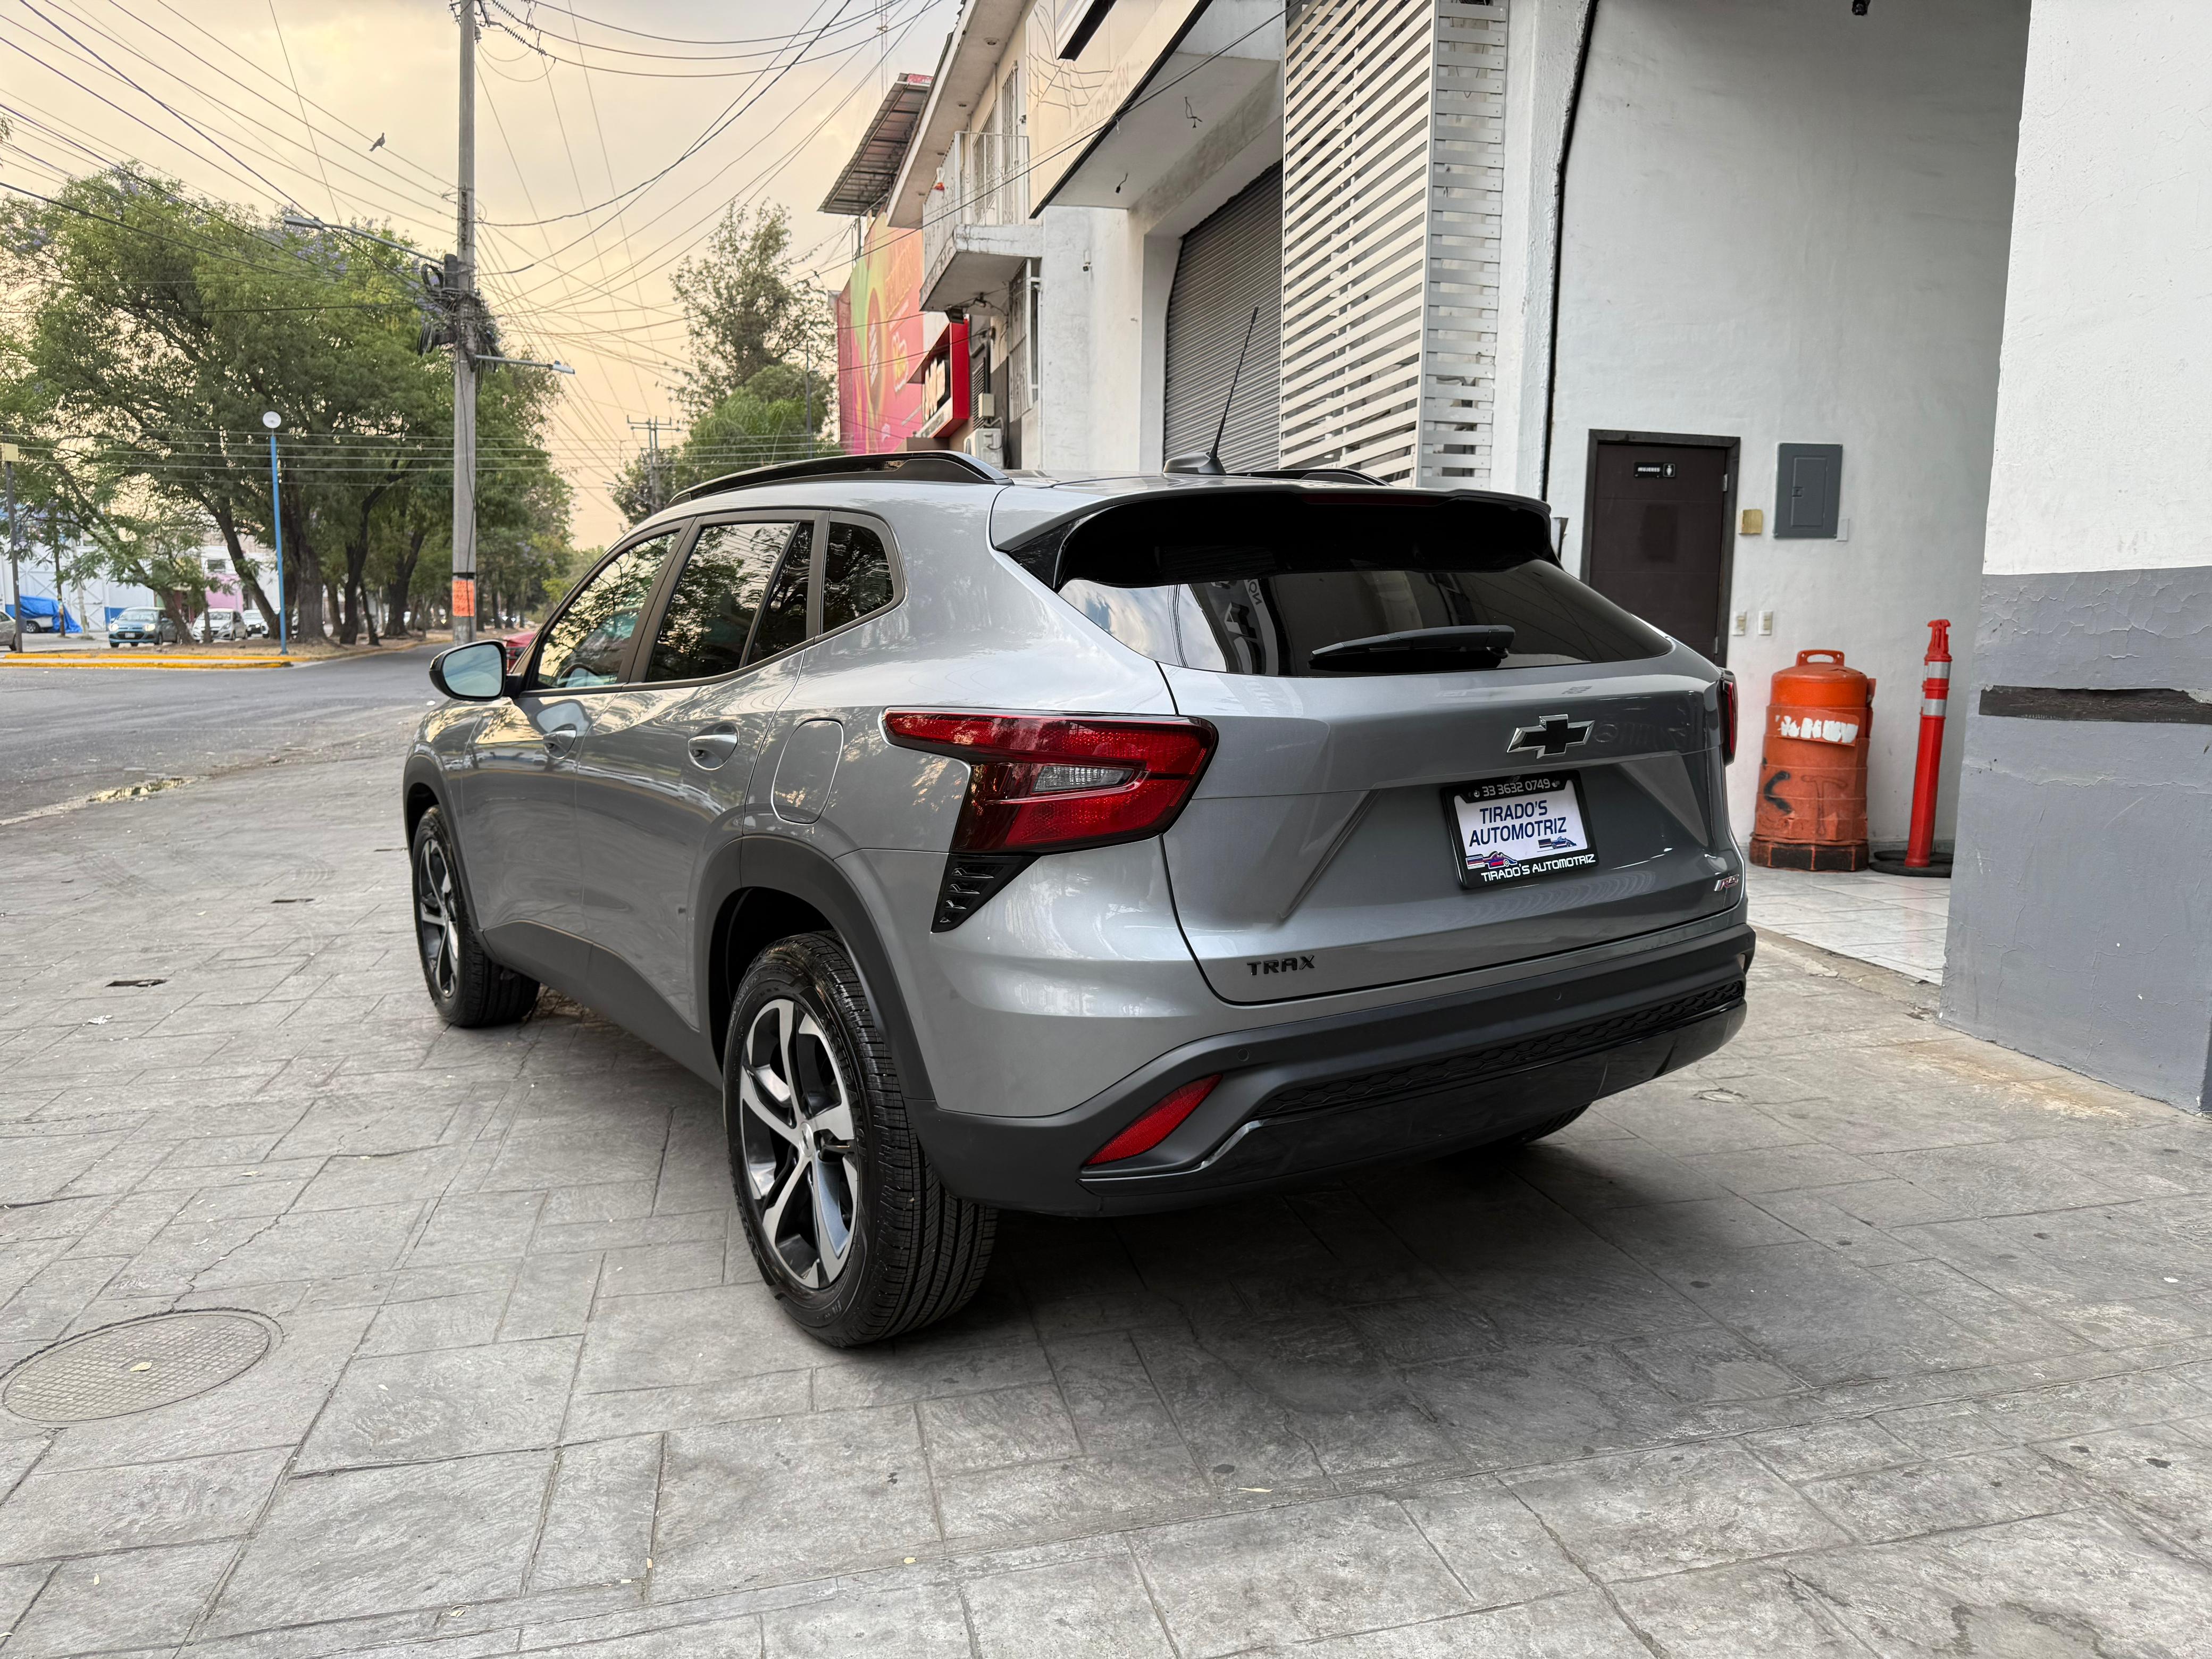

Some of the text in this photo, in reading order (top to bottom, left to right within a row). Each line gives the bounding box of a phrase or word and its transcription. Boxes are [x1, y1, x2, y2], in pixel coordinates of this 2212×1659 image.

[1482, 778, 1551, 797] 33 3632 0749
[1479, 799, 1548, 824] TIRADO'S
[1469, 817, 1567, 847] AUTOMOTRIZ
[1481, 853, 1596, 882] TIRADO'S AUTOMOTRIZ
[1714, 874, 1739, 891] RS
[1247, 955, 1315, 976] TRAX
